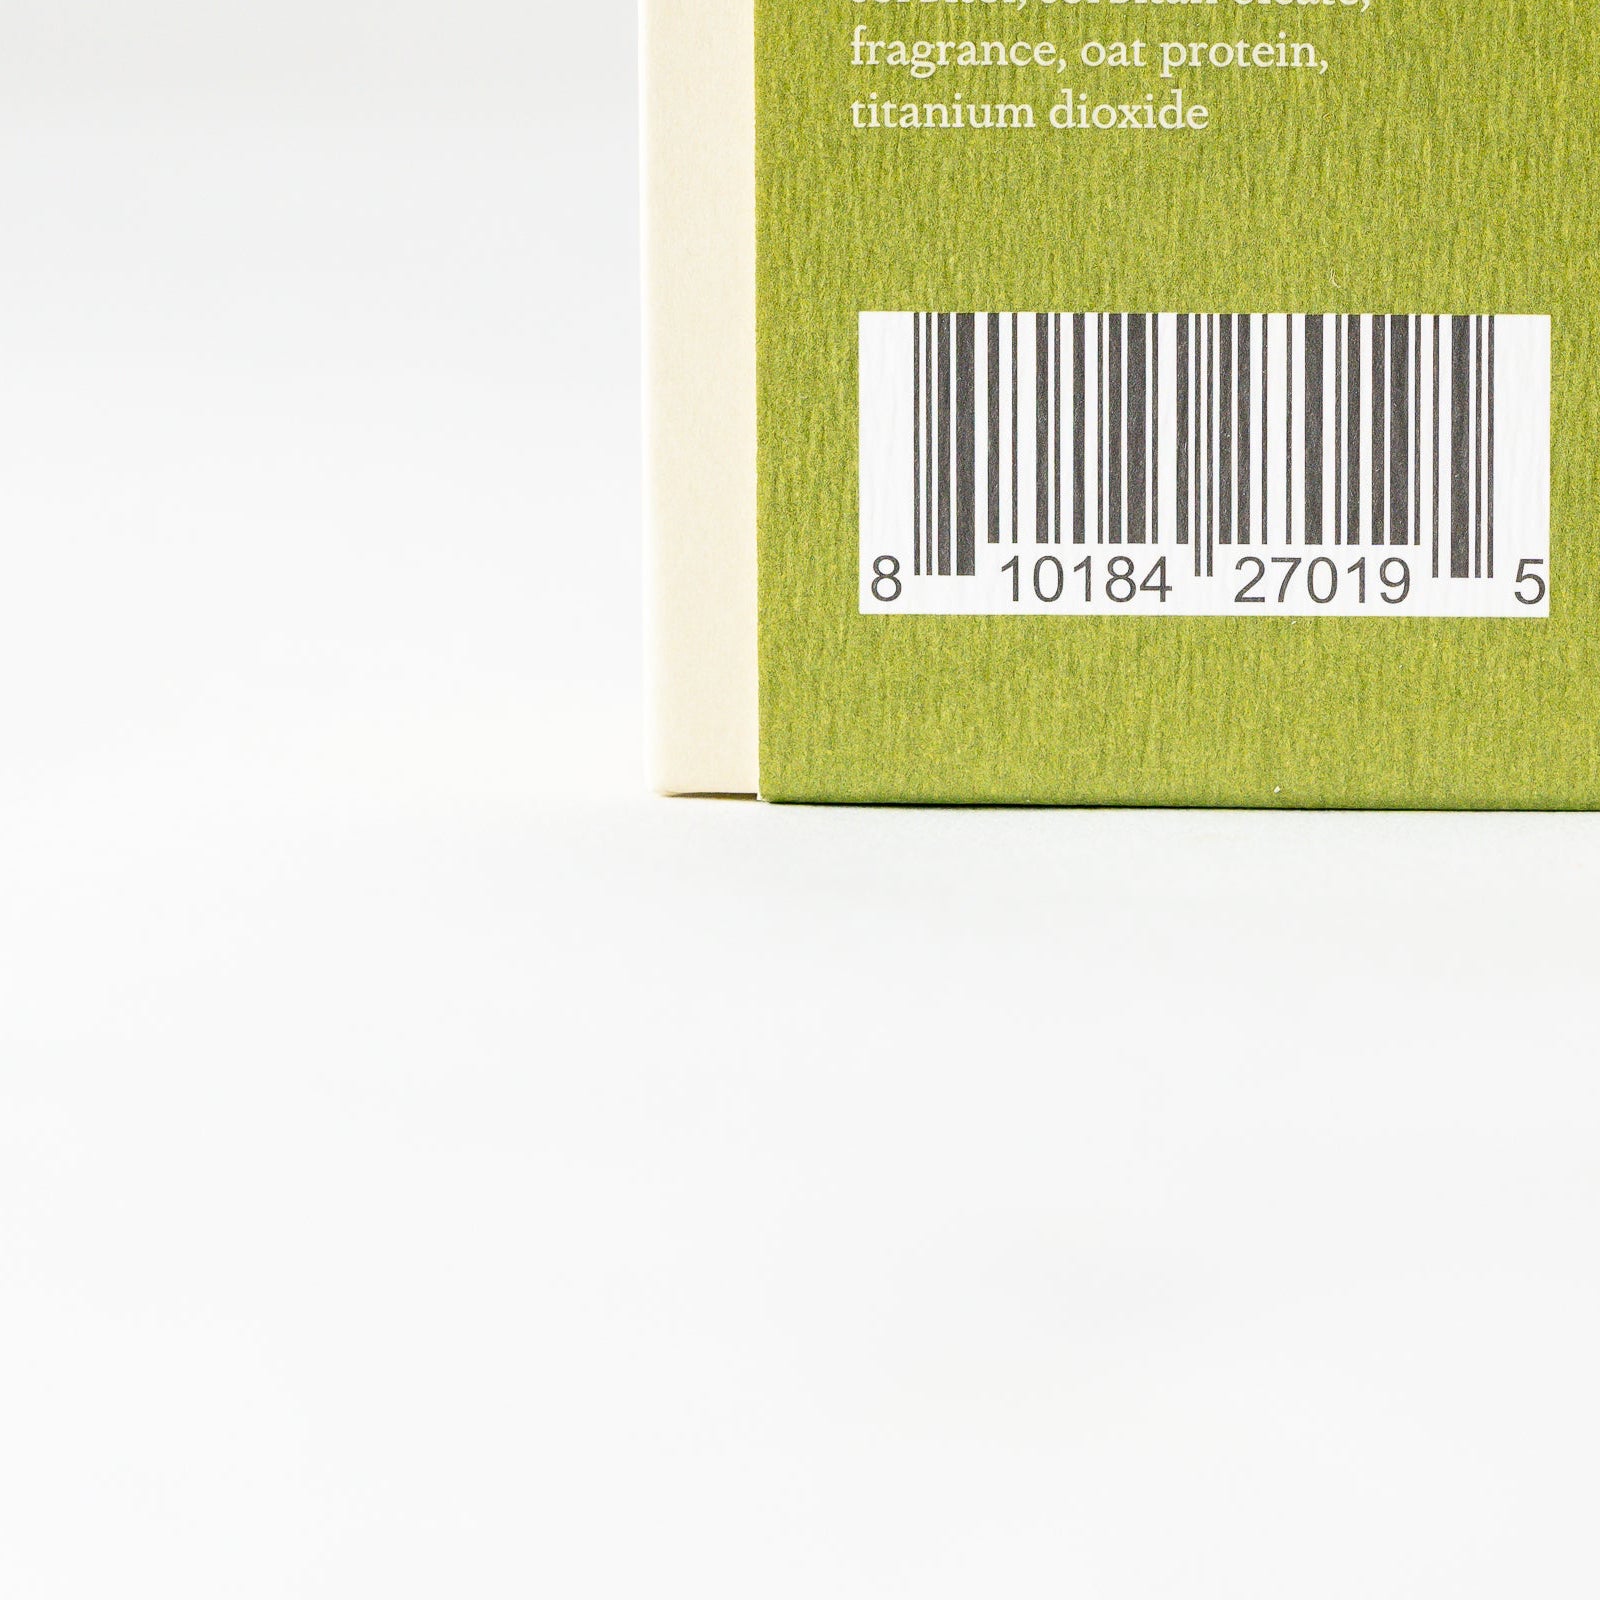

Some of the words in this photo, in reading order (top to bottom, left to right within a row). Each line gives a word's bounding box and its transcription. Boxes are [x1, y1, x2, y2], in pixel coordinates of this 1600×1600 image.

[851, 25, 1066, 78] fragrance,
[1081, 36, 1145, 66] oat
[1160, 32, 1327, 77] protein,
[851, 93, 1035, 128] titanium
[1050, 89, 1208, 129] dioxide
[872, 555, 901, 601] 8
[1002, 556, 1172, 602] 10184
[1235, 557, 1410, 604] 27019
[1515, 559, 1545, 604] 5
